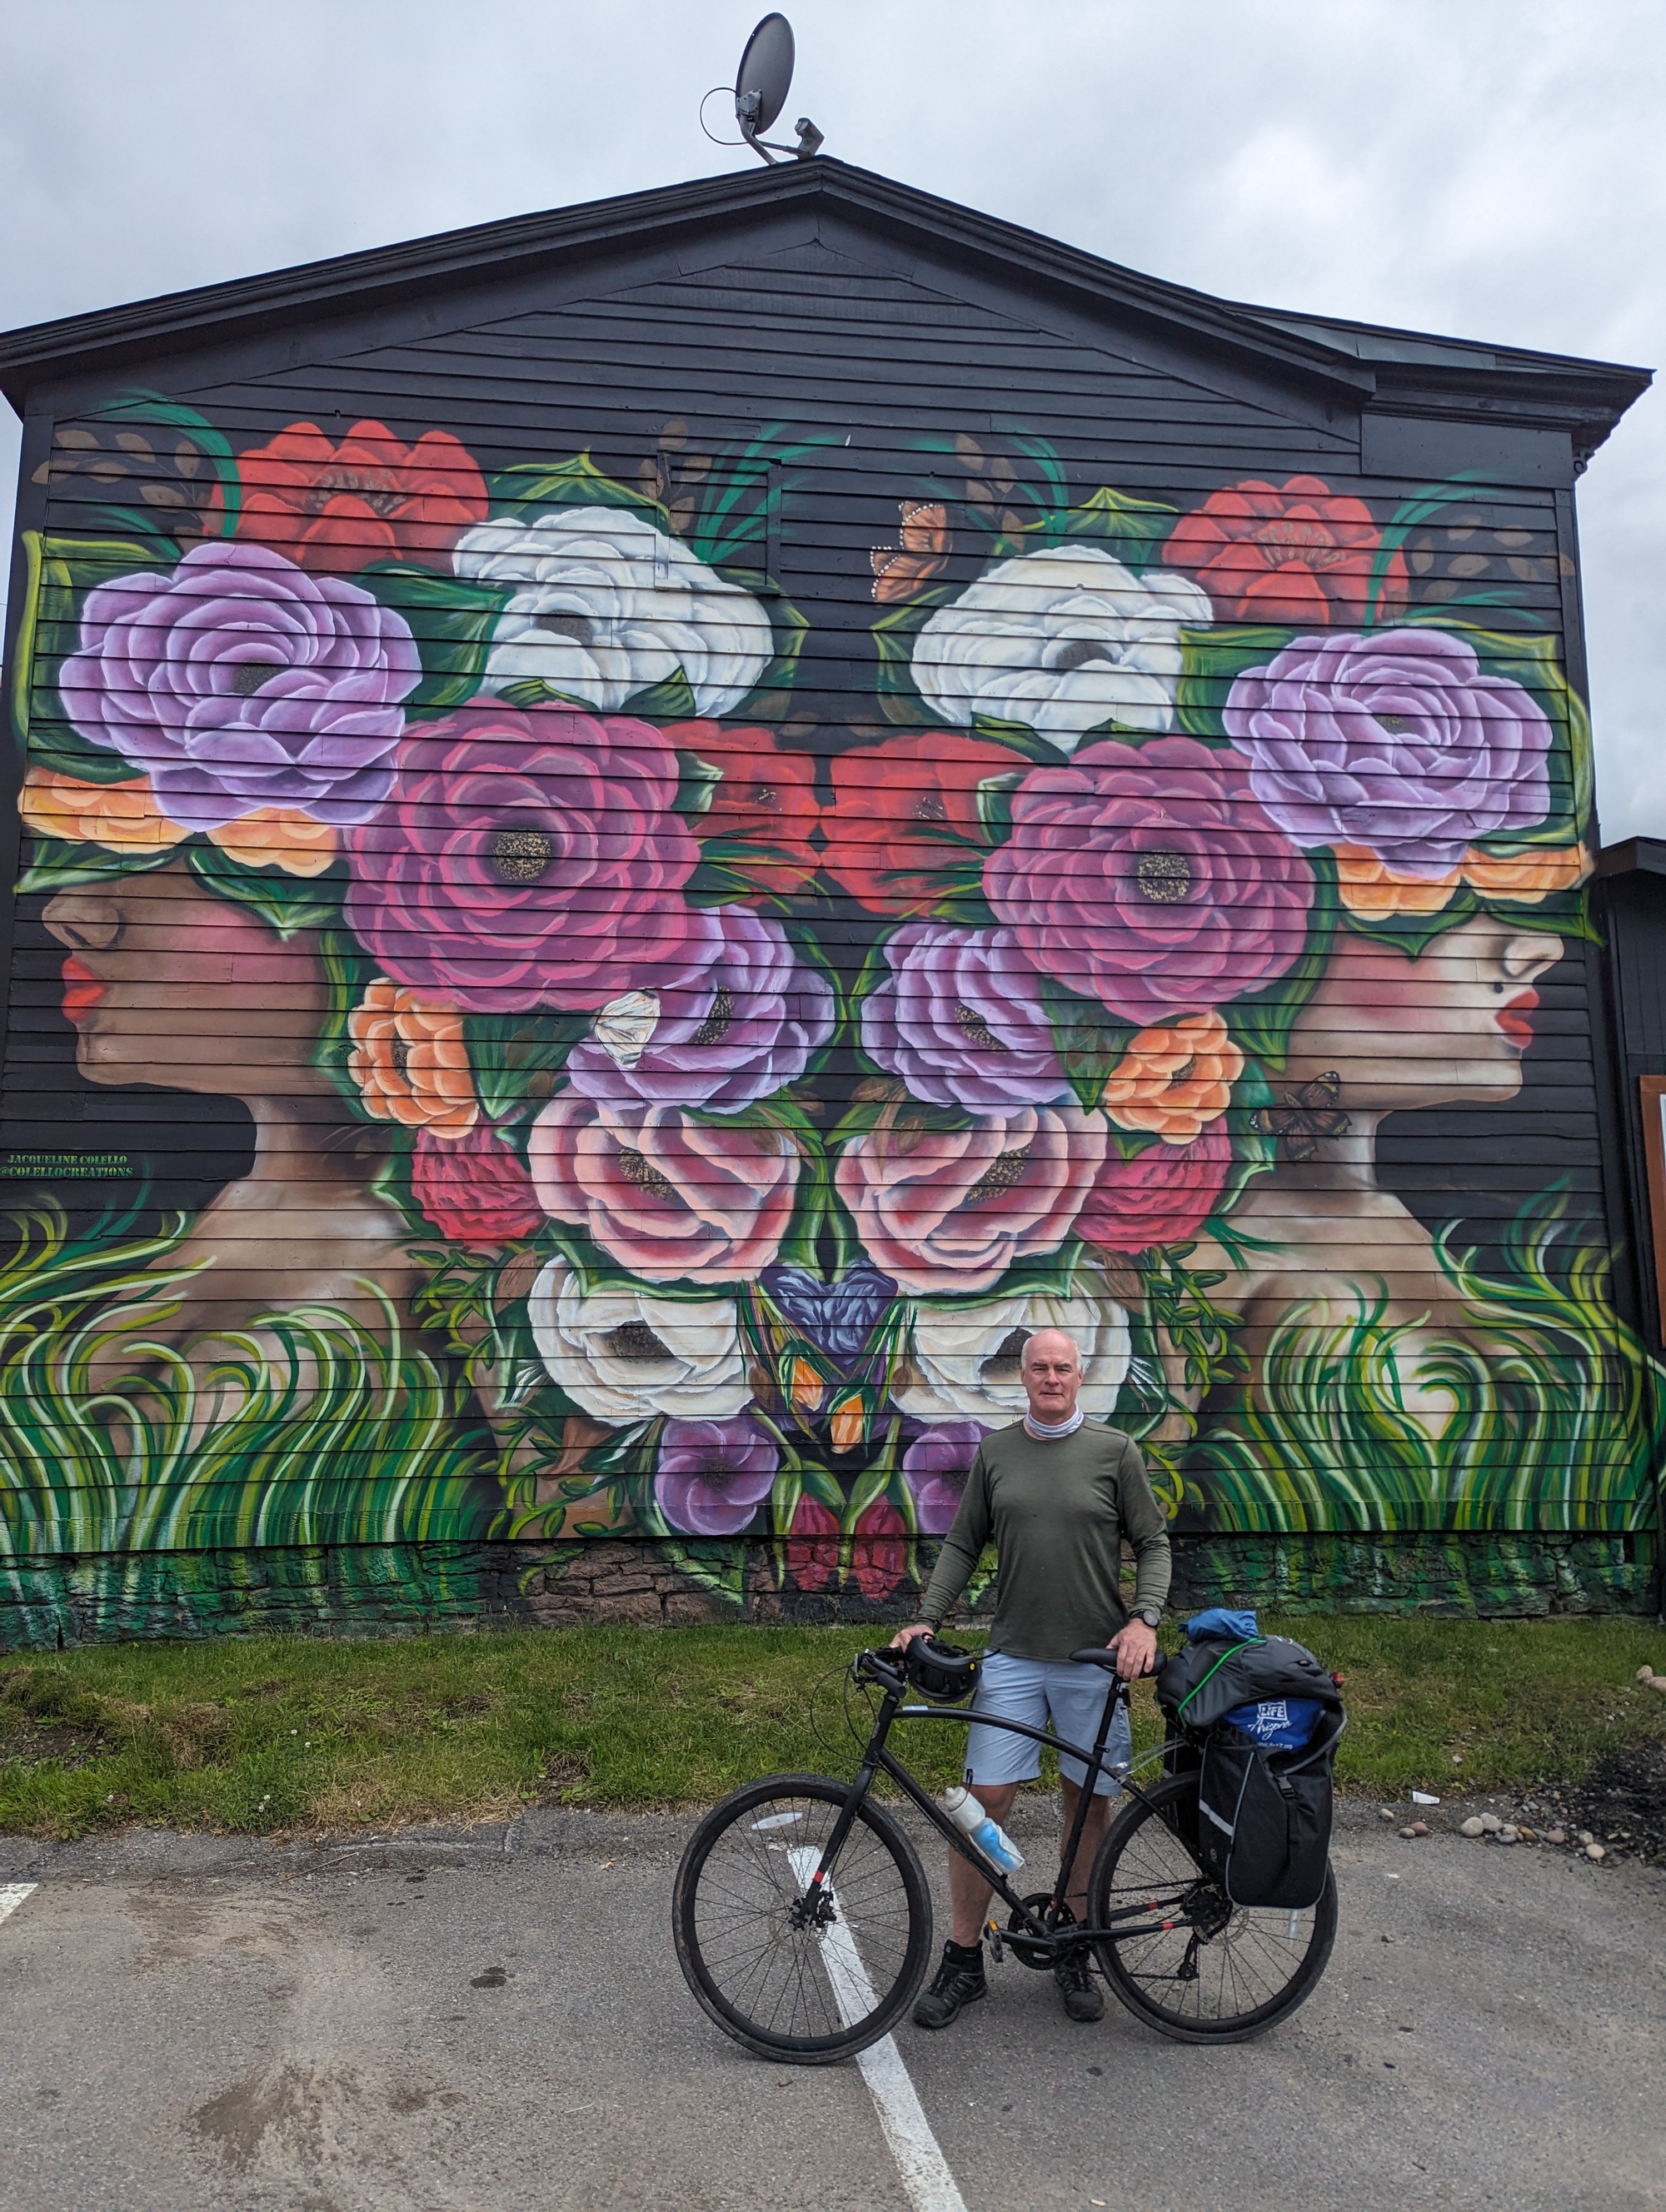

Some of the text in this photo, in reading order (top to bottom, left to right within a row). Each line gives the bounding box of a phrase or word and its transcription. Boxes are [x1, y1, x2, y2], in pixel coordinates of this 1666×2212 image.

[7, 1154, 127, 1164] JACQUELINE COLELLO
[1, 1167, 133, 1177] @COLELLOCREATIONS
[1248, 1718, 1293, 1741] Arizona
